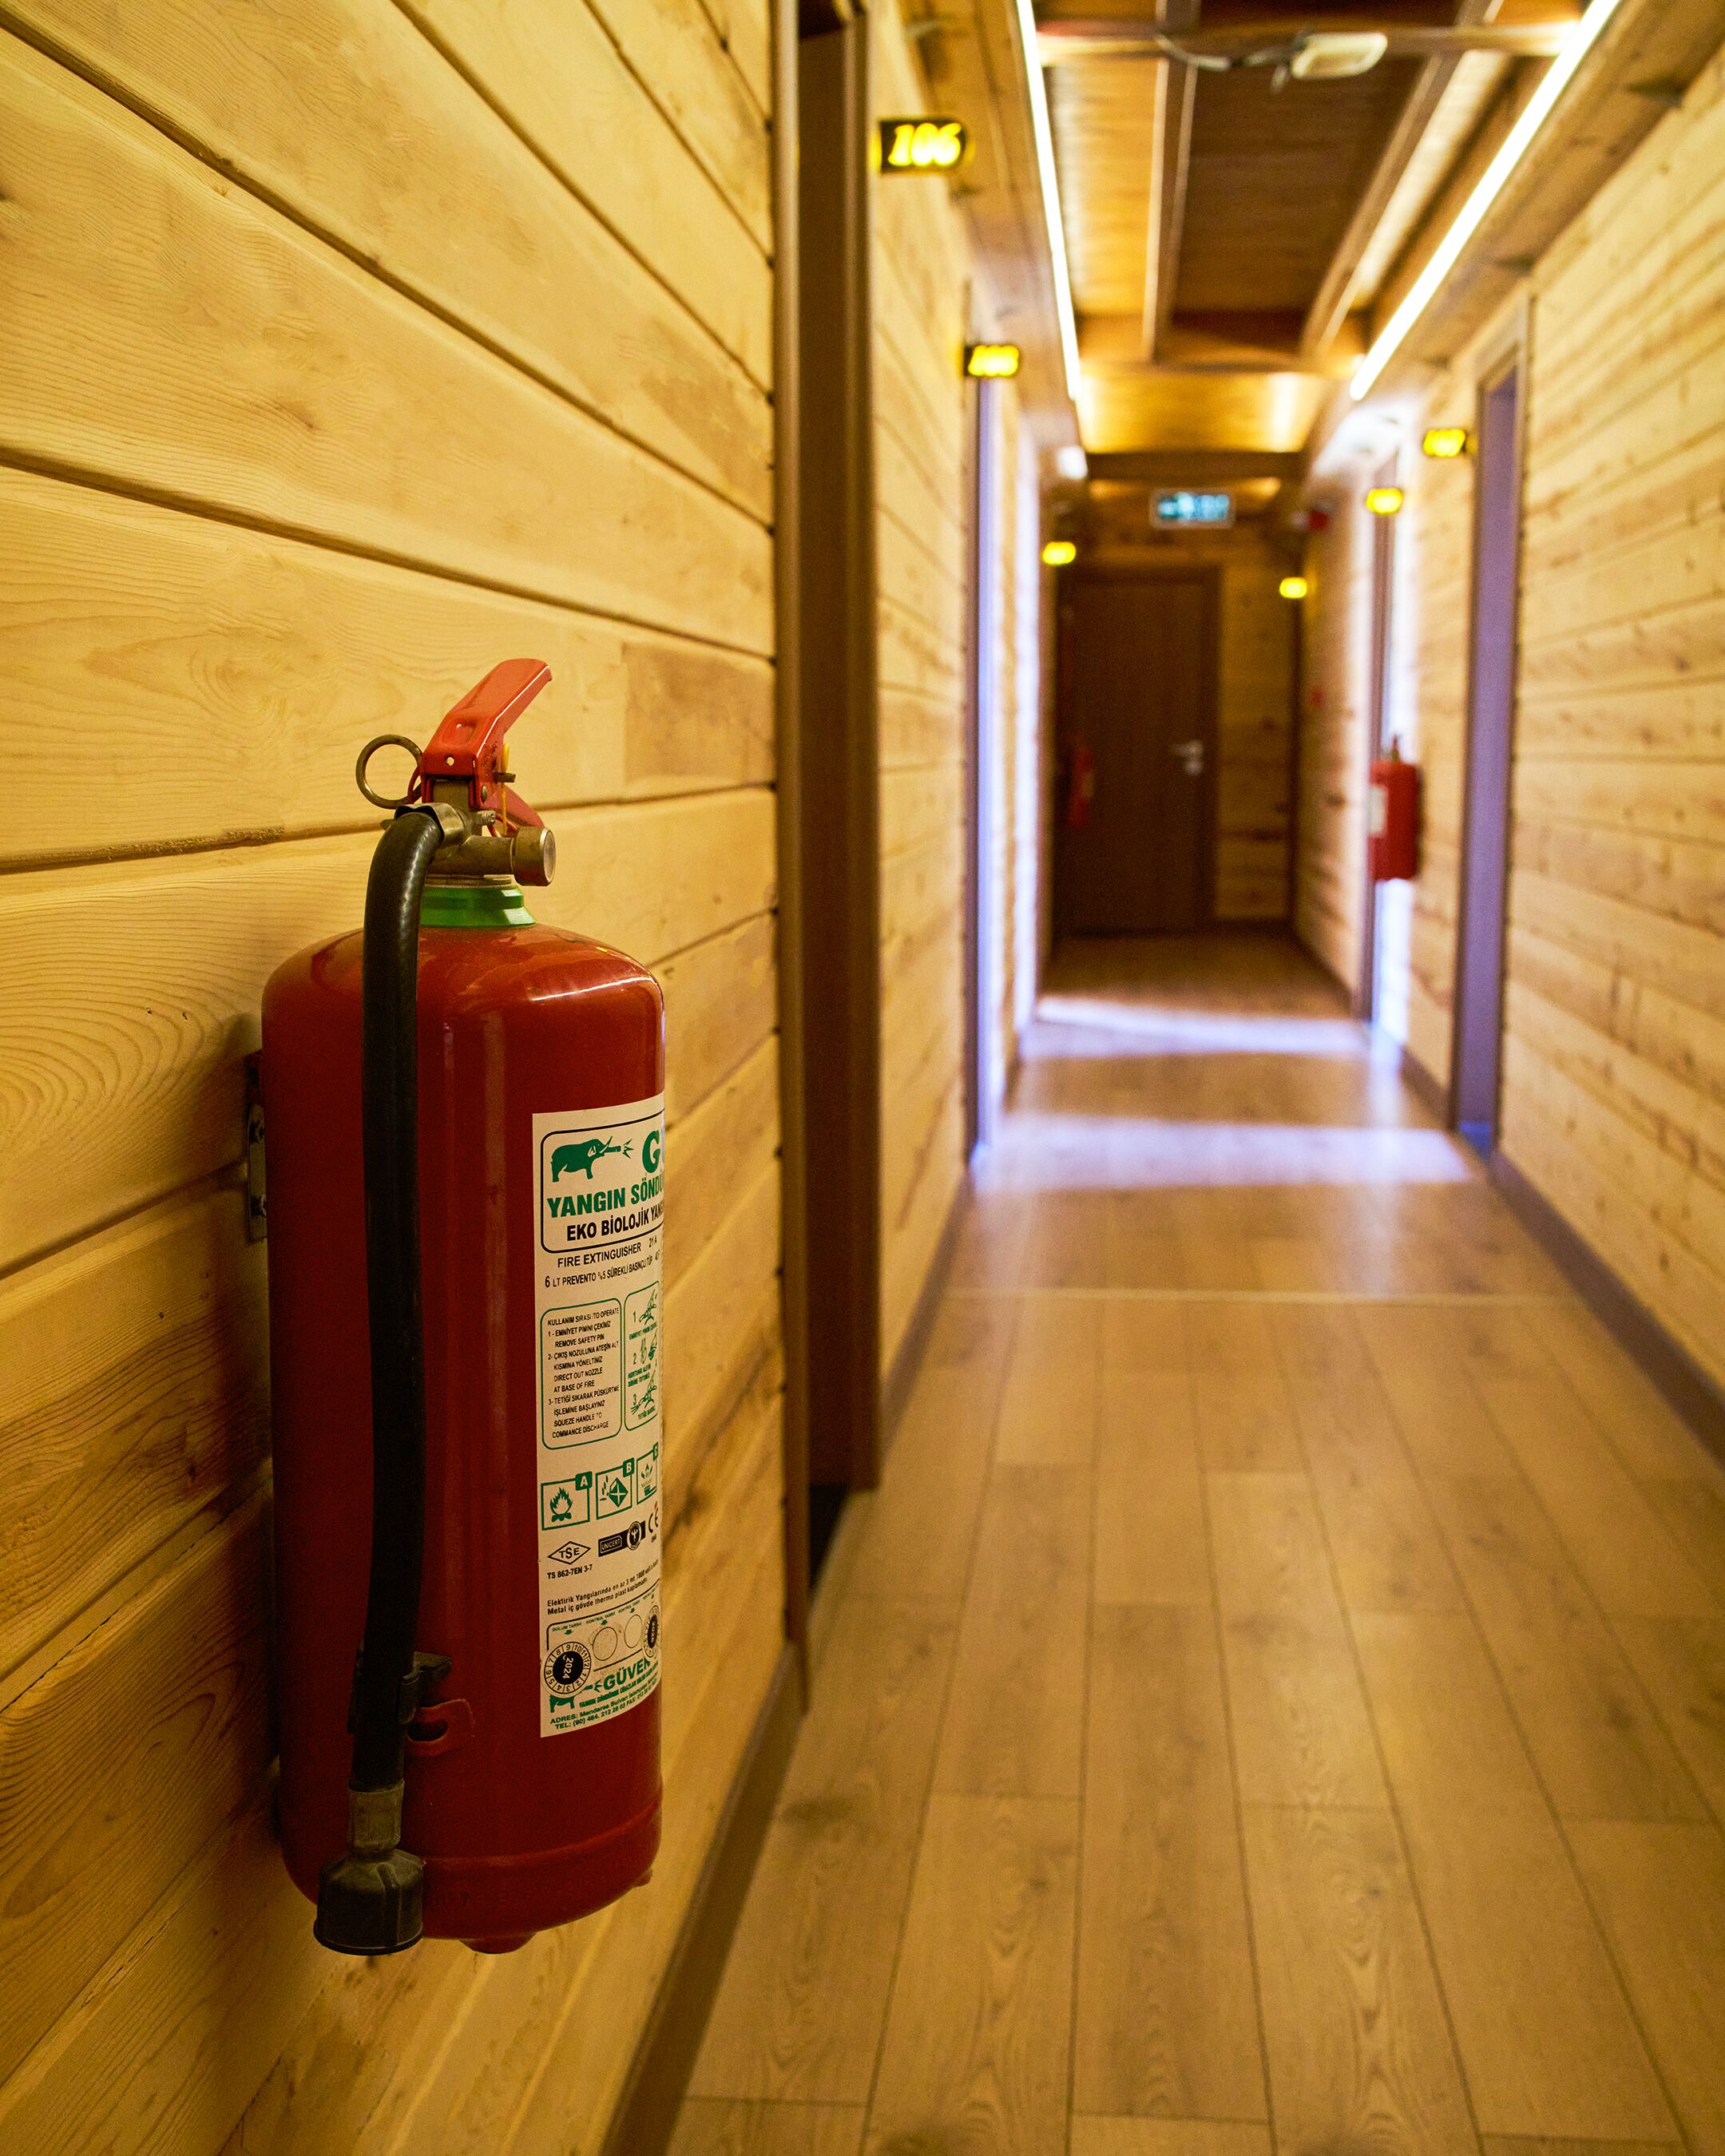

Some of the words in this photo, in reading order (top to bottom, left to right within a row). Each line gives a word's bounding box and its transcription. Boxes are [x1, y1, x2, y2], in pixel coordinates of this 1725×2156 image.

[642, 1128, 664, 1173] G
[546, 1187, 625, 1218] YANGIN
[567, 1223, 597, 1241] EKO
[601, 1207, 649, 1236] BİOLOJİK
[557, 1255, 581, 1268] FIRE
[584, 1242, 641, 1265] EXTINGUISHER
[545, 1276, 550, 1288] 6
[553, 1278, 561, 1287] LT
[562, 1272, 596, 1286] PREVENTO
[607, 1262, 629, 1278] SÜREKLİ
[548, 1316, 574, 1326] KULLANIM
[600, 1308, 619, 1317] OPERATE
[556, 1326, 577, 1337] EMNİYET
[555, 1339, 577, 1348] REMOVE
[577, 1335, 597, 1344] SAFETY
[585, 1367, 603, 1376] NOZZLE
[561, 1383, 575, 1392] BASE
[572, 1393, 593, 1401] SIKARAK
[553, 1417, 575, 1427] SQUEZE
[576, 1413, 595, 1423] HANDLE
[626, 1462, 632, 1472] B
[580, 1476, 589, 1487] A
[601, 1539, 621, 1550] UNICERT
[559, 1548, 580, 1559] TSE
[547, 1596, 573, 1607] Elektirik
[547, 1606, 566, 1615] Metal
[575, 1600, 593, 1611] gövde
[595, 1595, 613, 1604] thermo
[562, 1657, 573, 1678] 2024
[604, 1657, 650, 1690] GÜVEN
[550, 1714, 577, 1724] ADRES:
[580, 1704, 609, 1717] Menderes
